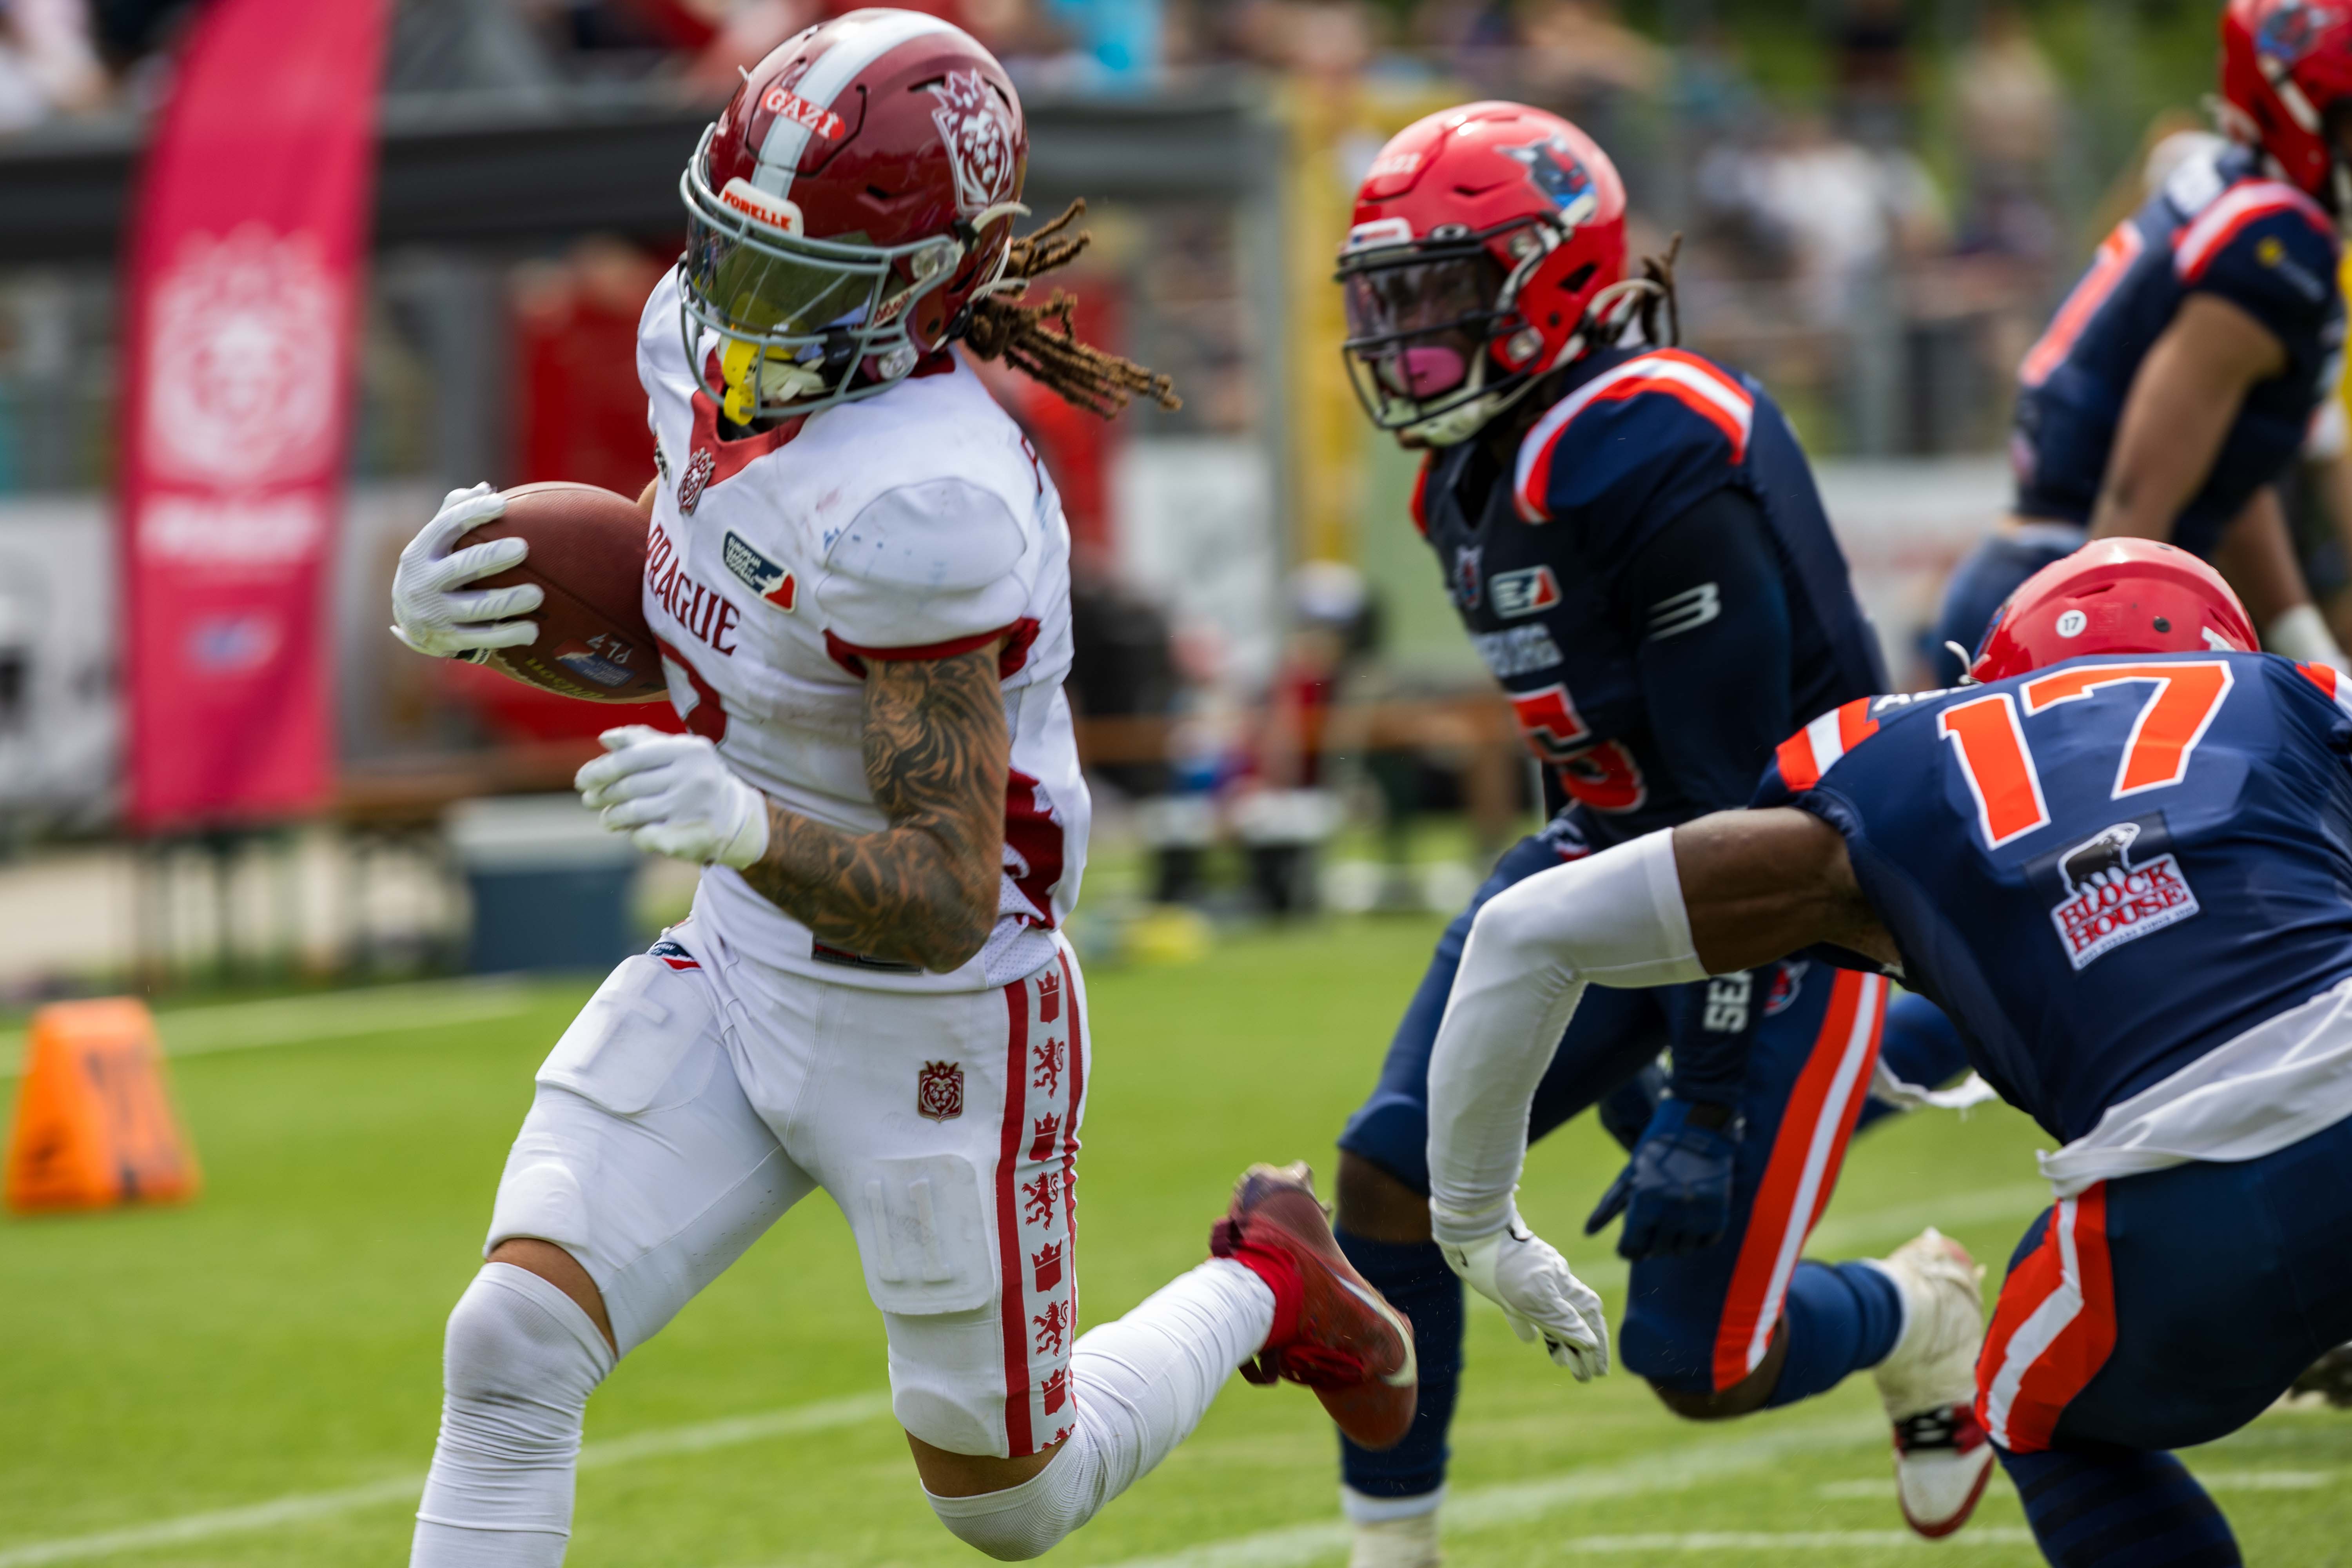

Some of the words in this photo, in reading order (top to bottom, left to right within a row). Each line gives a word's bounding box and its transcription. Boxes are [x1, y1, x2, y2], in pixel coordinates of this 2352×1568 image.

[722, 189, 791, 230] FORELLE
[2063, 616, 2080, 632] 17
[1937, 660, 2235, 850] 17
[2058, 860, 2178, 930] BLOCK
[2069, 882, 2188, 955] HOUSE
